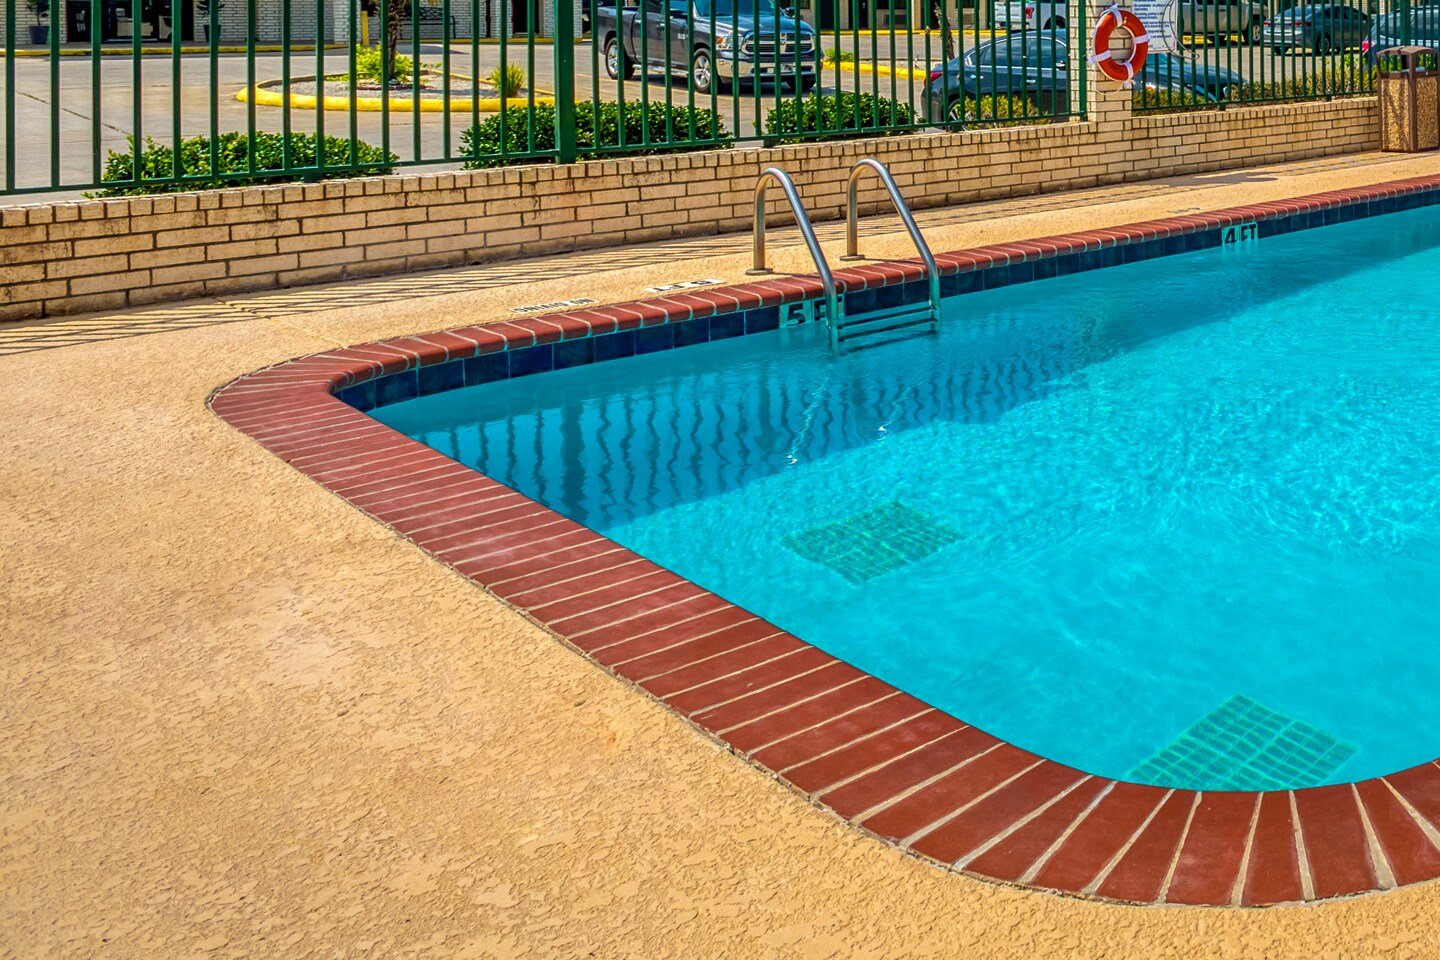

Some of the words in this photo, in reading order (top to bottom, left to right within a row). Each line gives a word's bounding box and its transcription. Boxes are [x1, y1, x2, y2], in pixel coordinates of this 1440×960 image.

[1224, 227, 1237, 244] 4
[1240, 223, 1257, 242] FT
[785, 302, 807, 327] 5
[813, 294, 843, 322] F
